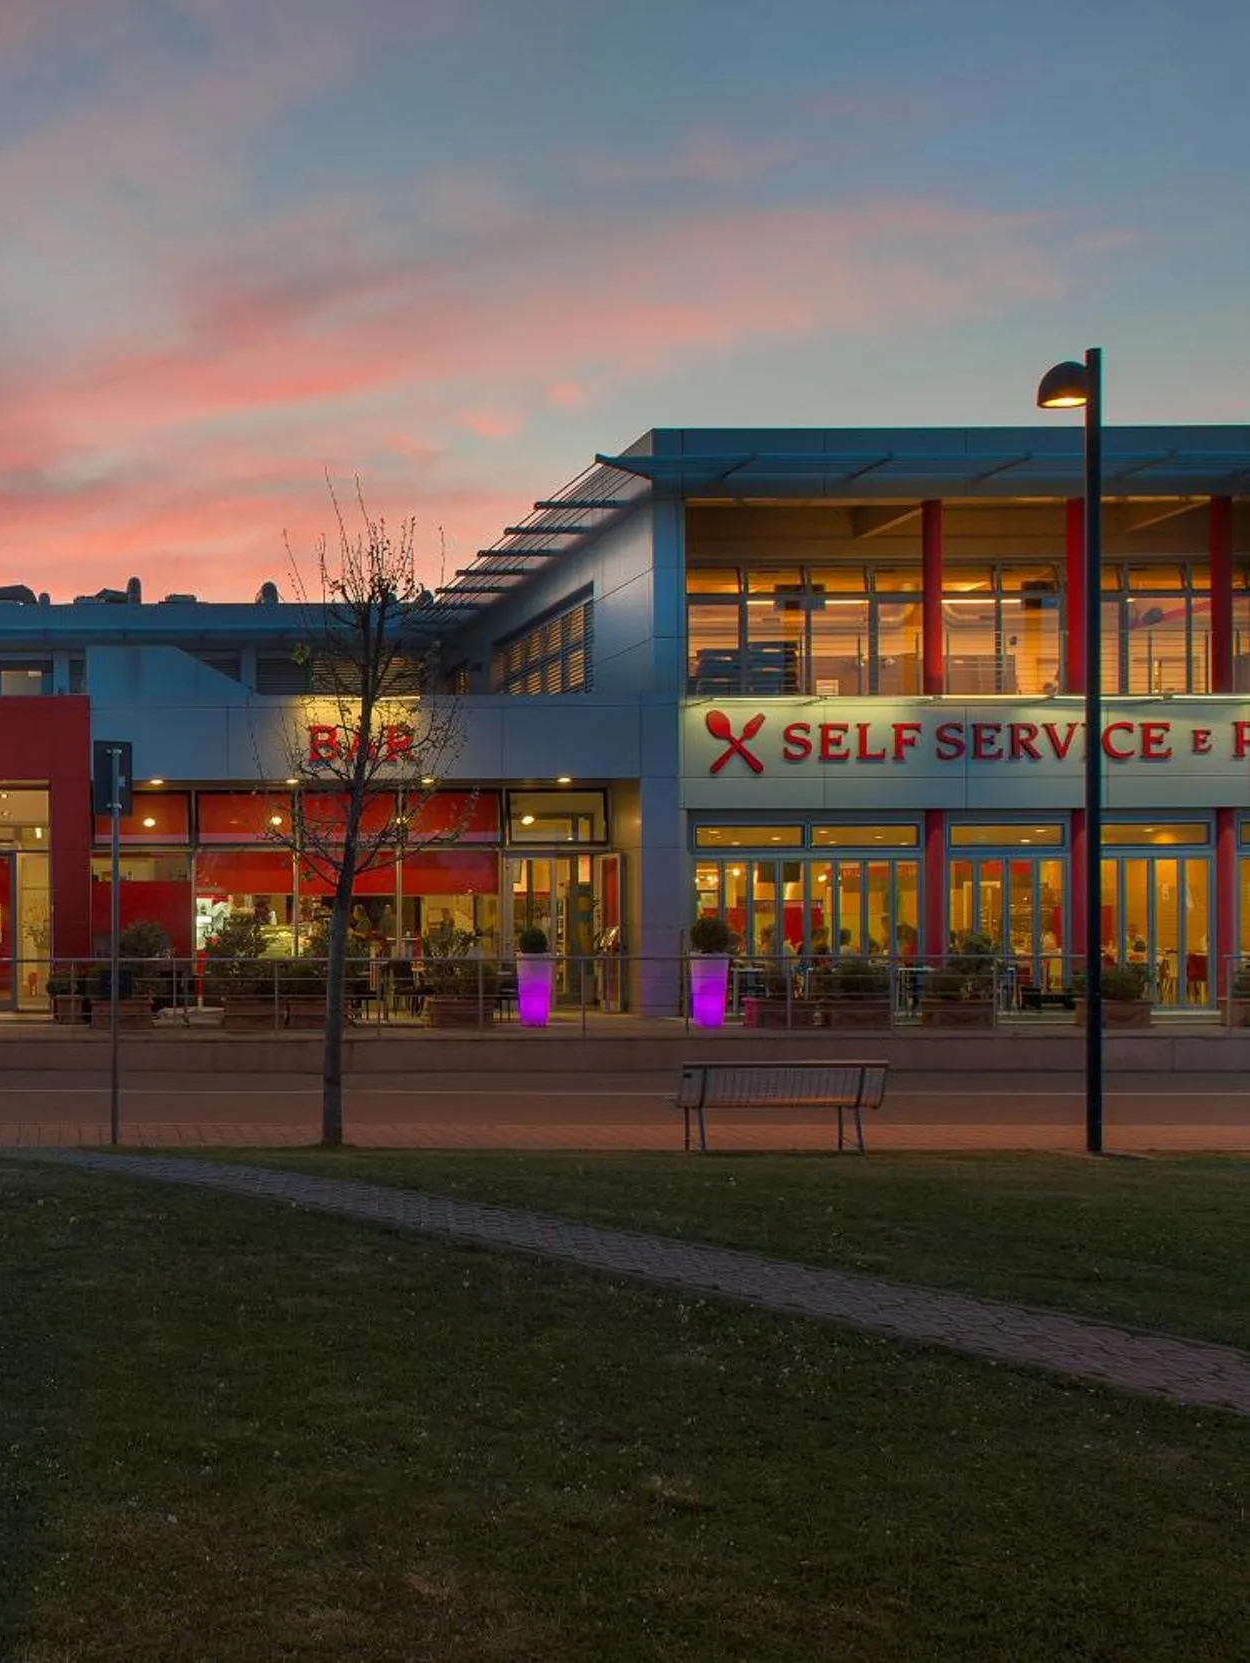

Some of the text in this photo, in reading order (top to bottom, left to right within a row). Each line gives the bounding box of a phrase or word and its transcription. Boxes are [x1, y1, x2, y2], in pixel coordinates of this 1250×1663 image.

[782, 722, 922, 761] SELF
[935, 720, 1173, 761] SERVCE
[1191, 728, 1213, 754] E
